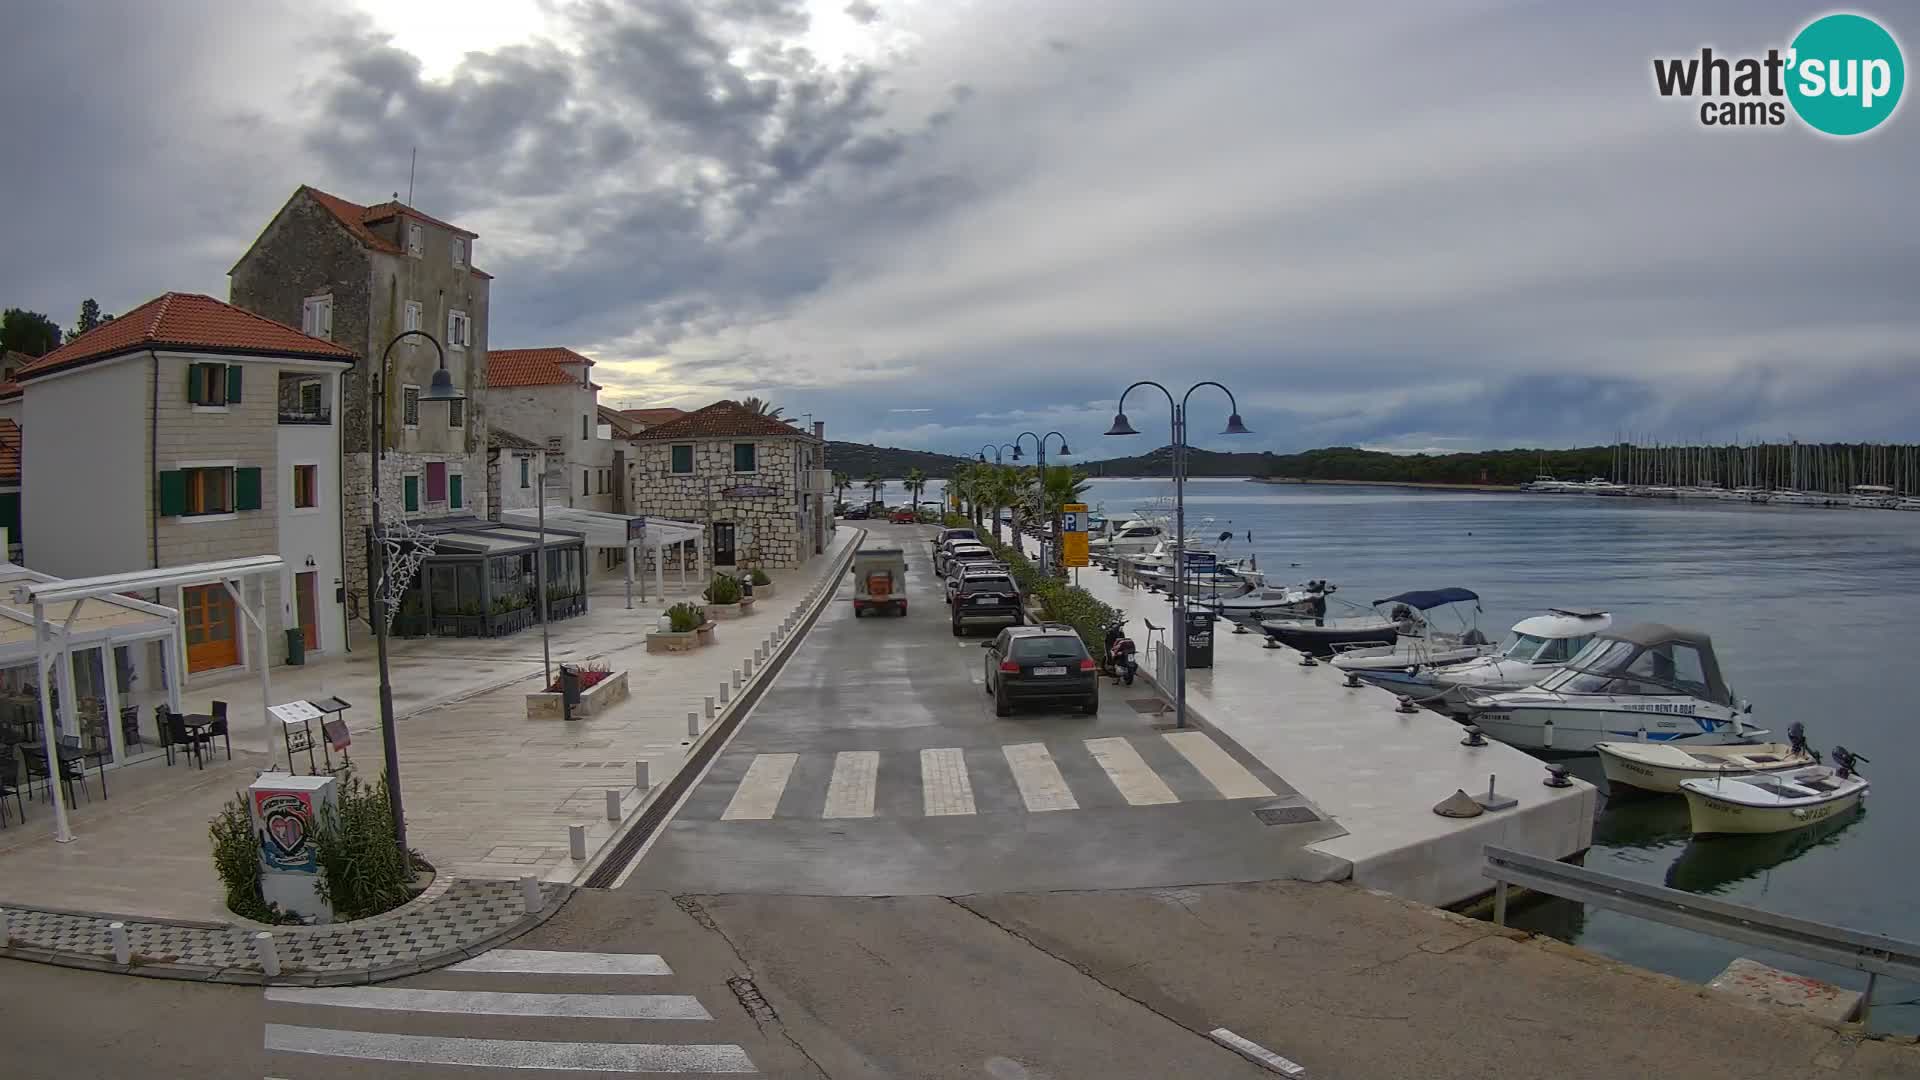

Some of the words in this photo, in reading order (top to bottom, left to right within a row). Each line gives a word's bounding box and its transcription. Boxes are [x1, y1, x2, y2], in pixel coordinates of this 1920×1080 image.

[1064, 514, 1076, 530] P
[1654, 703, 1672, 713] RENT
[1673, 704, 1678, 713] A
[1679, 704, 1696, 715] BOAT
